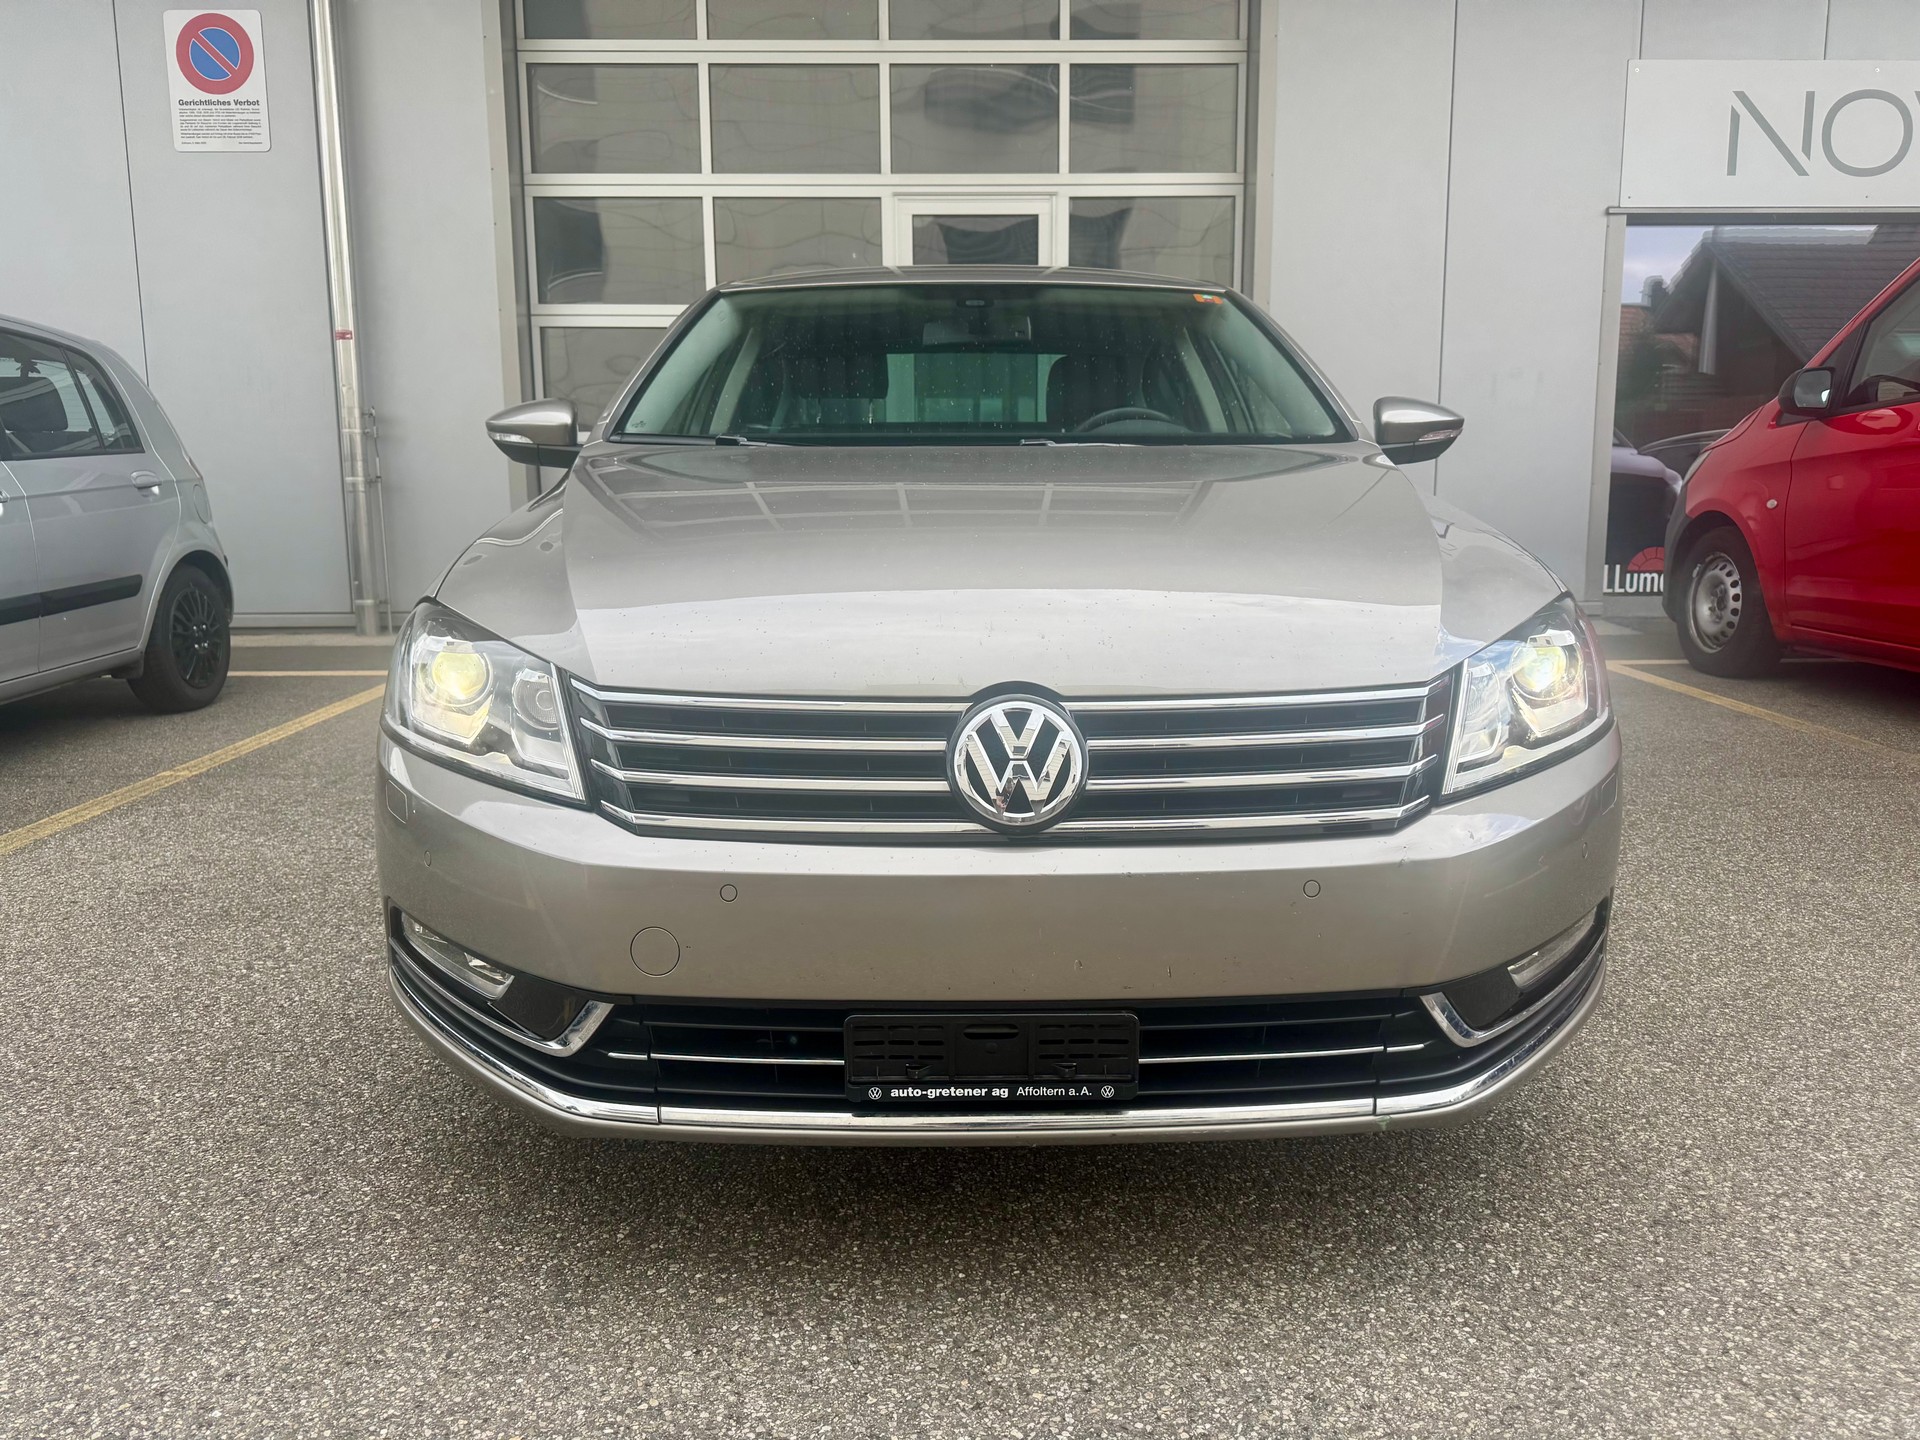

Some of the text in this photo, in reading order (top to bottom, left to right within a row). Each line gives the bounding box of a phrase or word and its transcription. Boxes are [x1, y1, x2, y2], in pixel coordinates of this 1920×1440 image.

[1727, 89, 1920, 177] NO
[954, 701, 1082, 826] VW
[890, 1087, 988, 1099] auto-gretener
[991, 1088, 1009, 1099] ag
[1016, 1086, 1066, 1096] Affoltern
